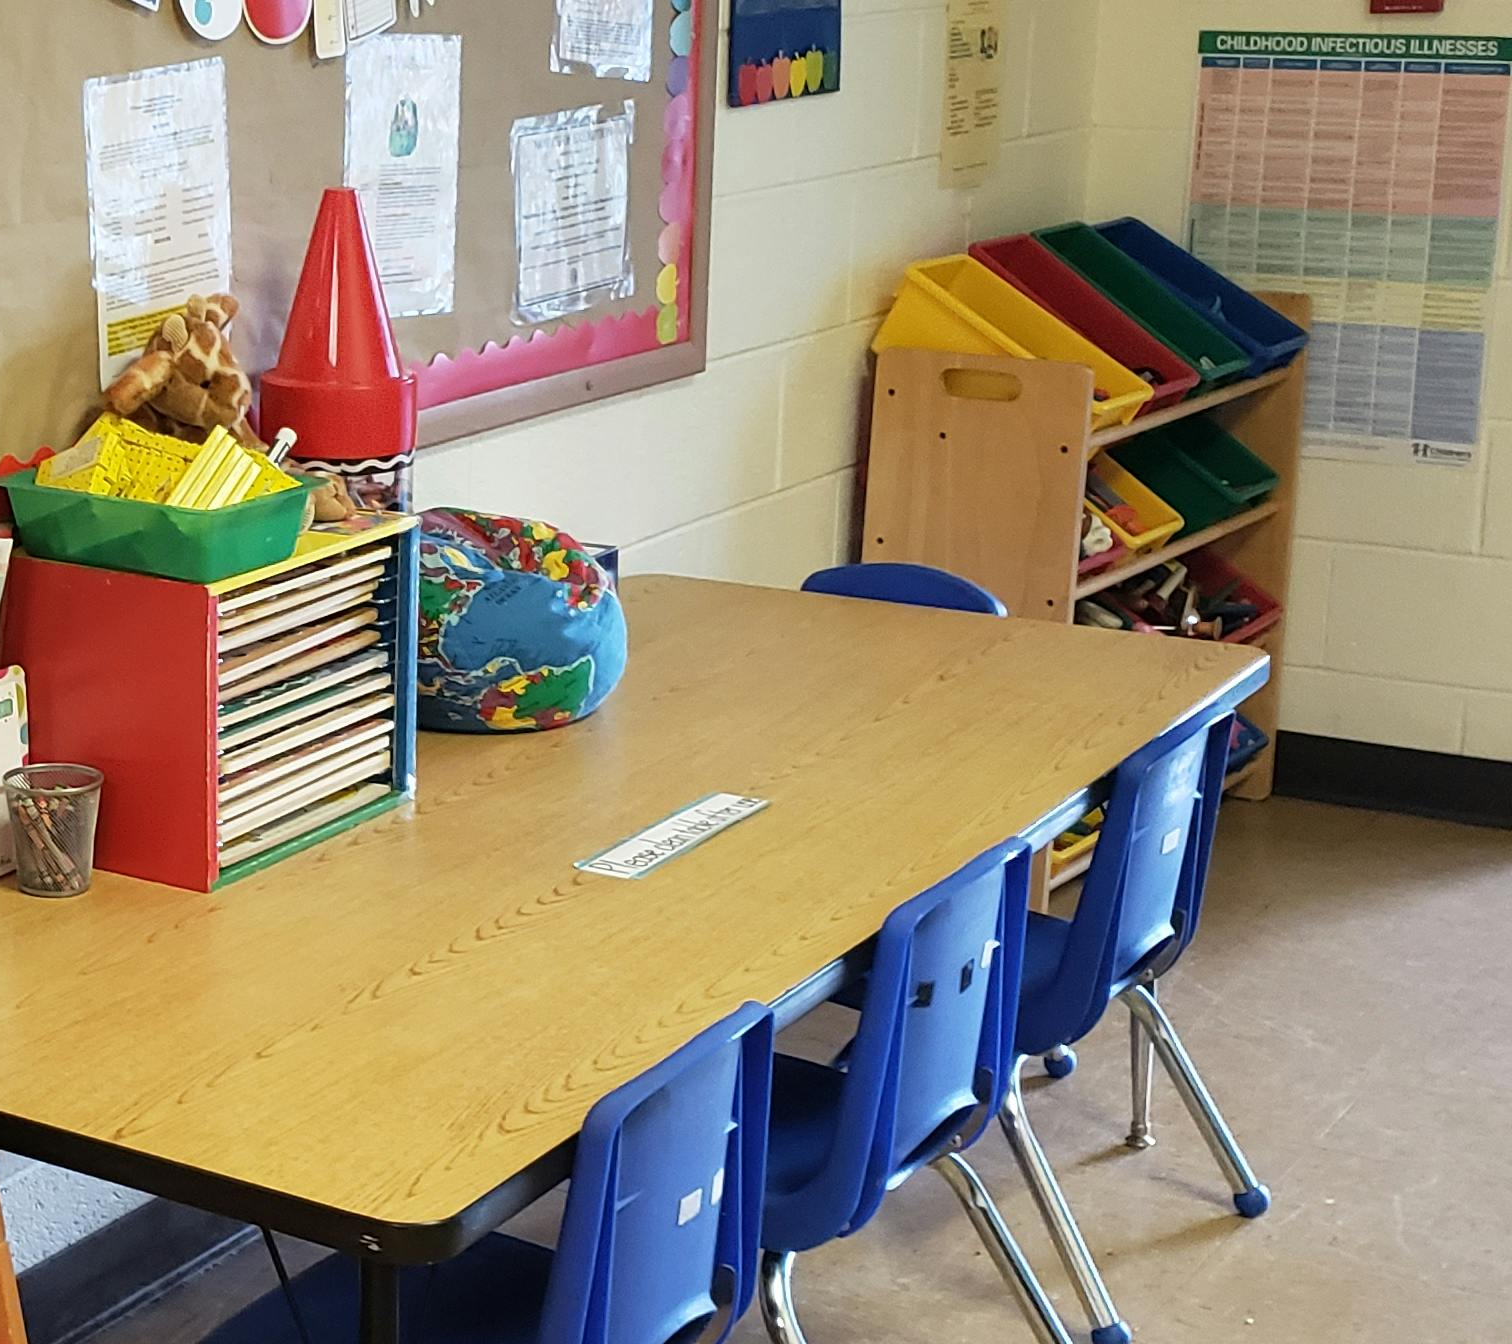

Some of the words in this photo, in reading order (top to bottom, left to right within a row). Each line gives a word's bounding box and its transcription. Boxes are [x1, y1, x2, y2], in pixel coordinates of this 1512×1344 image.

[1215, 35, 1308, 53] CHILDHOOD
[1311, 37, 1406, 55] INFECTIOUS
[1410, 39, 1499, 57] ILLNESSES
[588, 848, 665, 874] Please
